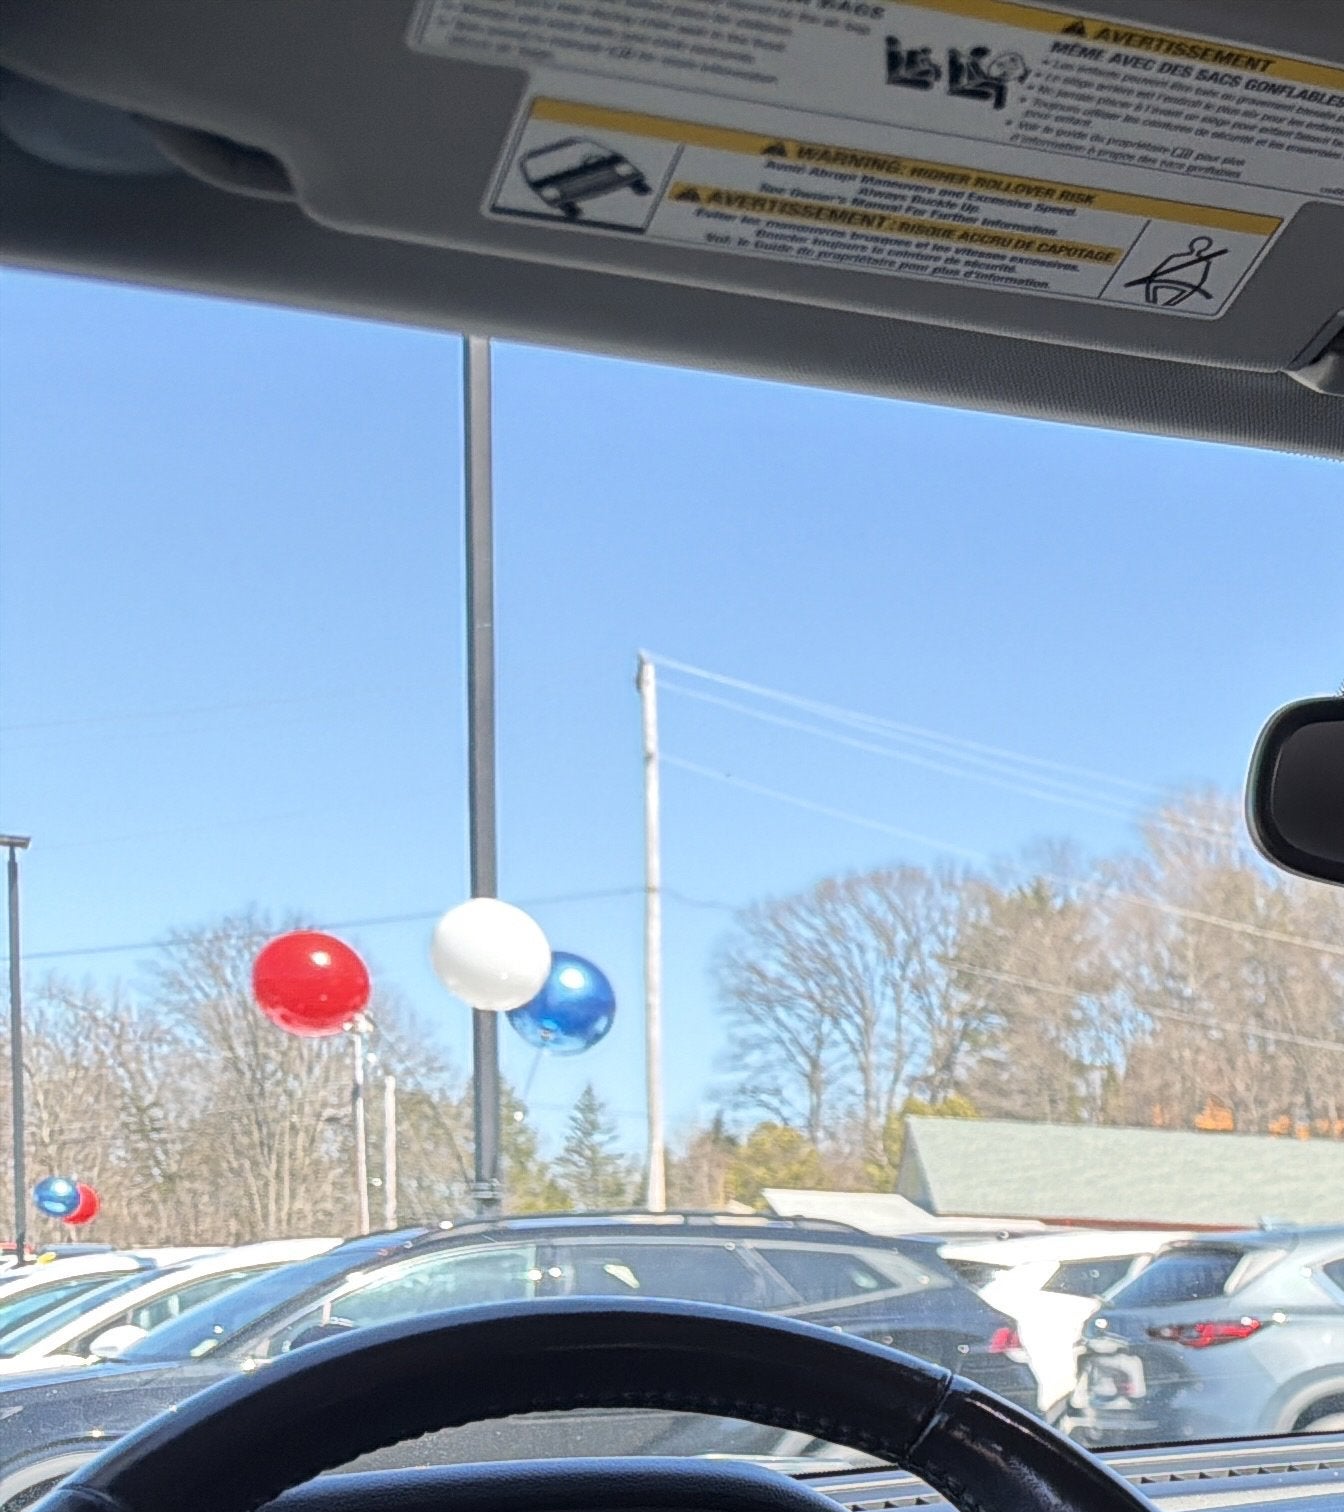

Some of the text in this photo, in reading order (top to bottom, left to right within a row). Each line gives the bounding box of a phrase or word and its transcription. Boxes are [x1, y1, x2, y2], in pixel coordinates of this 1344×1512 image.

[1092, 26, 1276, 73] AVERTISSEMENT
[1106, 51, 1158, 71] AVEC
[1156, 60, 1196, 78] DES
[1193, 67, 1245, 87] SACS
